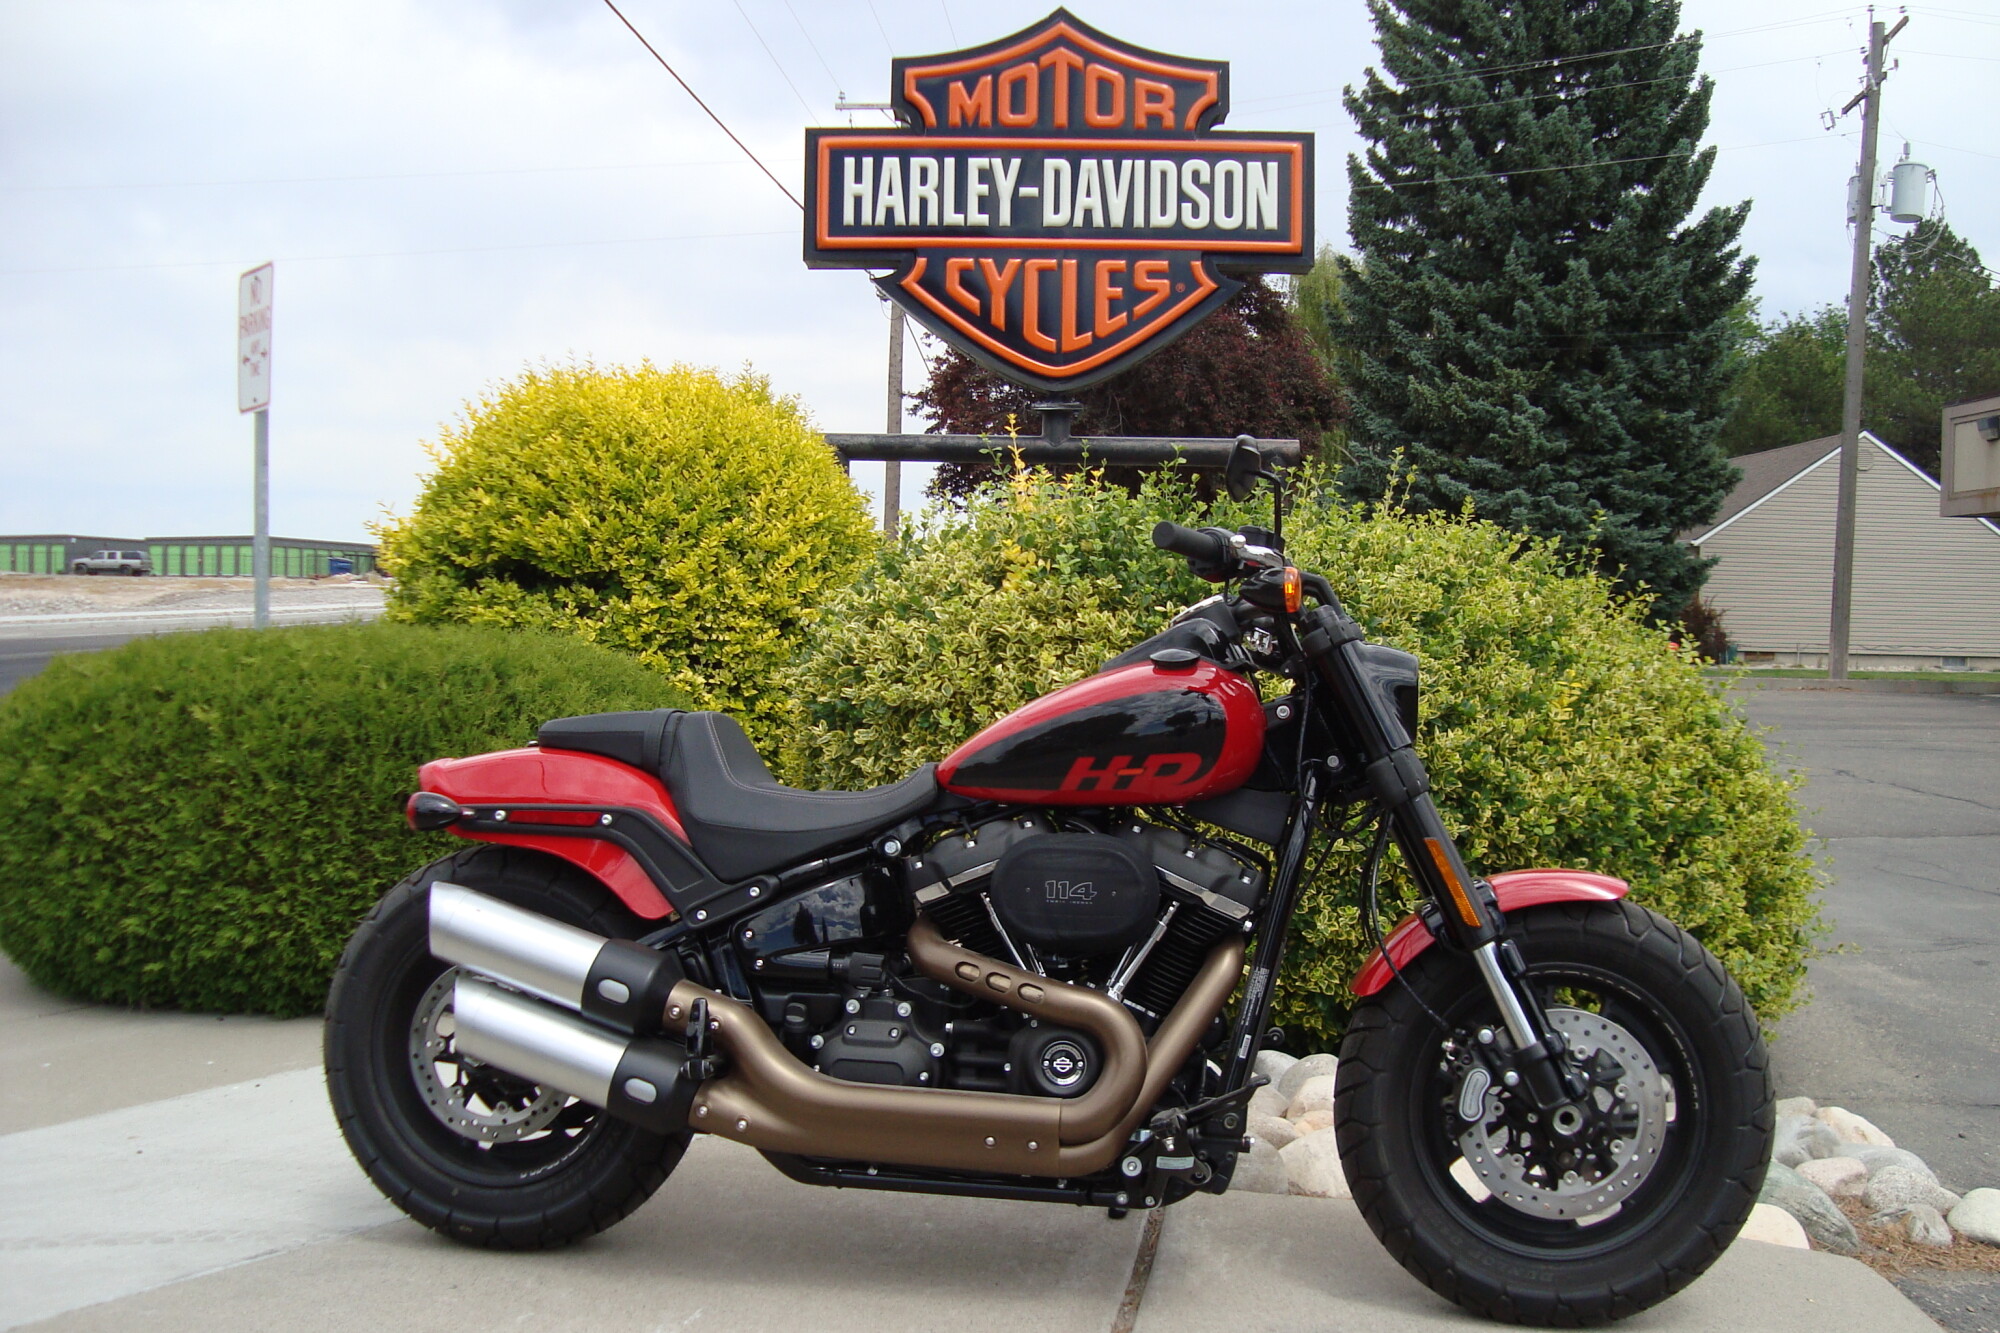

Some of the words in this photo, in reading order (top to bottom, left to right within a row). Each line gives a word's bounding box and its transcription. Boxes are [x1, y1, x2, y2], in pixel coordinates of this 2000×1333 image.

[948, 46, 1176, 130] MOTOR
[842, 156, 1279, 231] HARLEY-DAVIDSON
[945, 257, 1171, 354] CYCLES
[1057, 752, 1203, 793] H-D
[1044, 880, 1098, 900] 114
